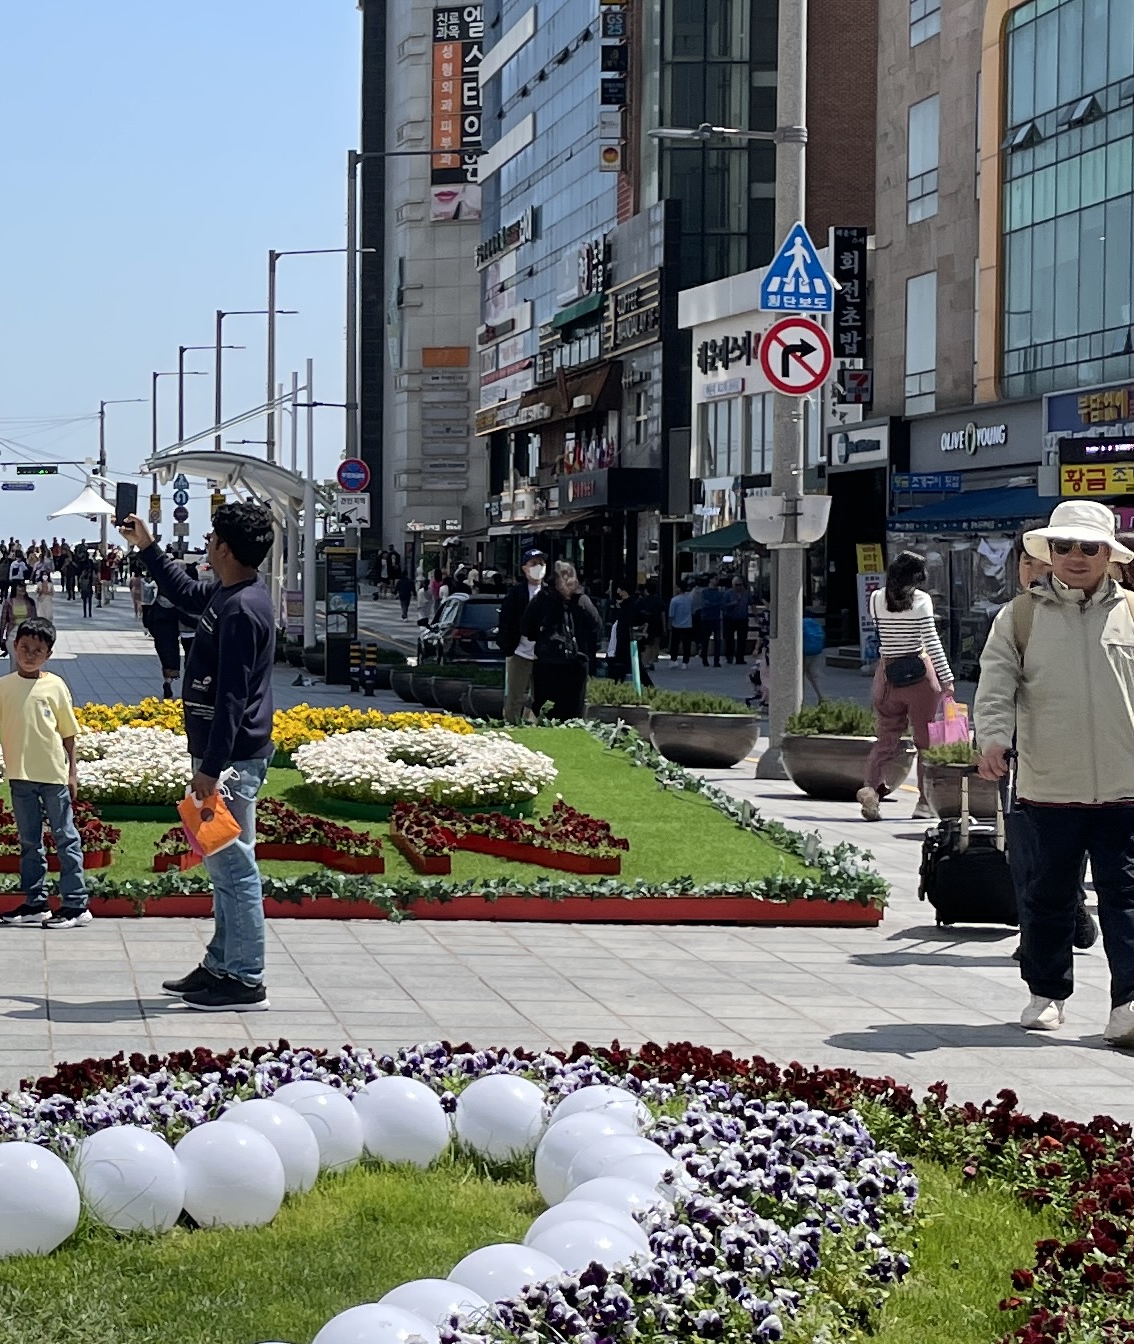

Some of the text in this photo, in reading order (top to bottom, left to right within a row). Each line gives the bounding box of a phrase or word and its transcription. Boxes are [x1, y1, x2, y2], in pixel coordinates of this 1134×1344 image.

[606, 14, 623, 24] GS
[607, 25, 623, 35] 25
[767, 294, 827, 309] 횡단보도
[839, 250, 862, 355] 회전초밥
[941, 424, 1007, 452] OLIVE YOUNG
[1064, 468, 1107, 492] 황금
